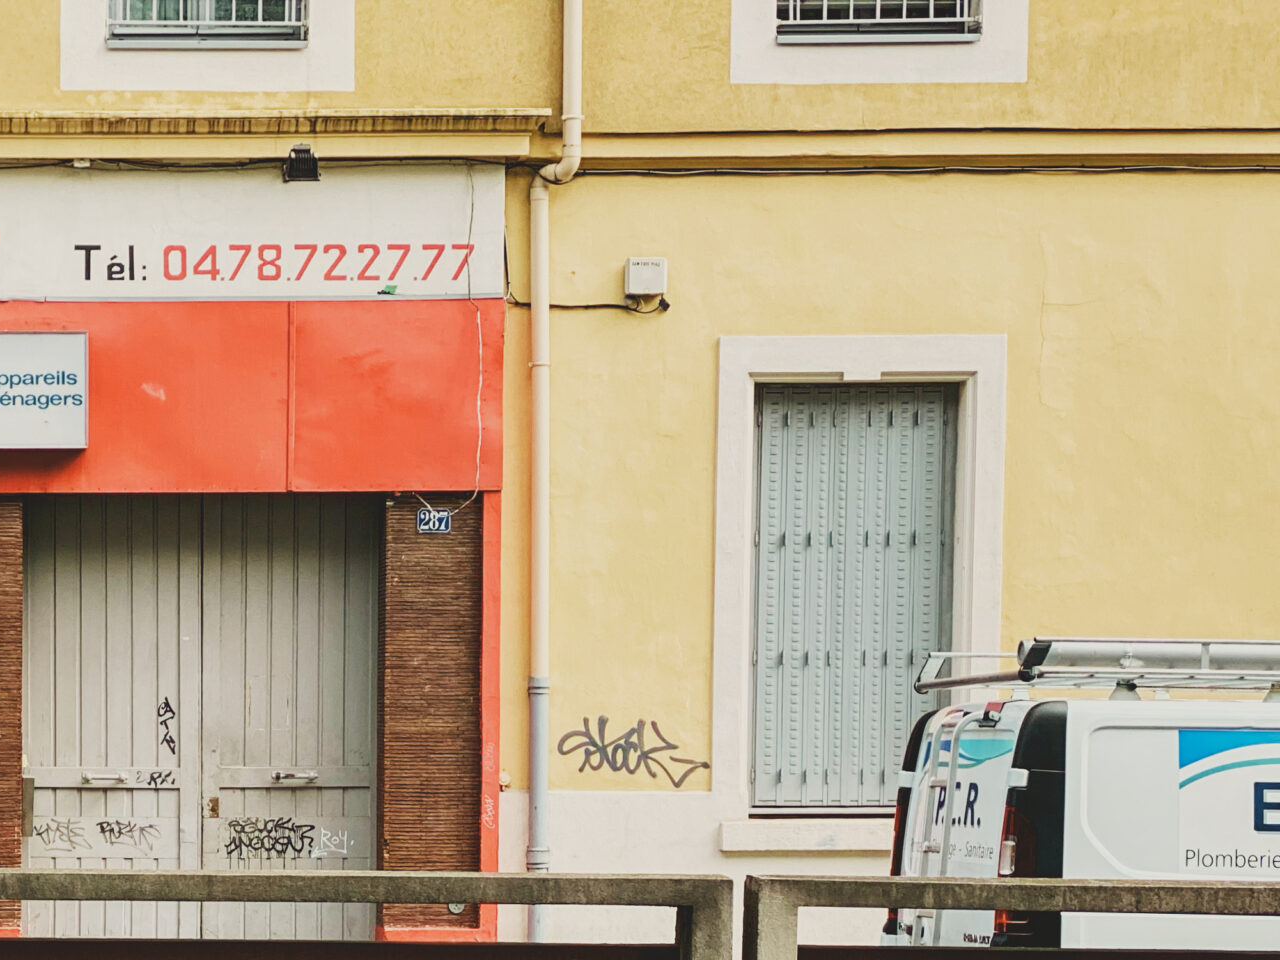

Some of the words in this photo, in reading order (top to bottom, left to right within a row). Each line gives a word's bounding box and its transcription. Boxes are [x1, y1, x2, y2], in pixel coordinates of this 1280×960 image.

[74, 244, 147, 281] Tél:
[162, 244, 475, 282] 04.78.72.27.77
[420, 510, 448, 531] 287
[1185, 848, 1280, 869] Plomberie
